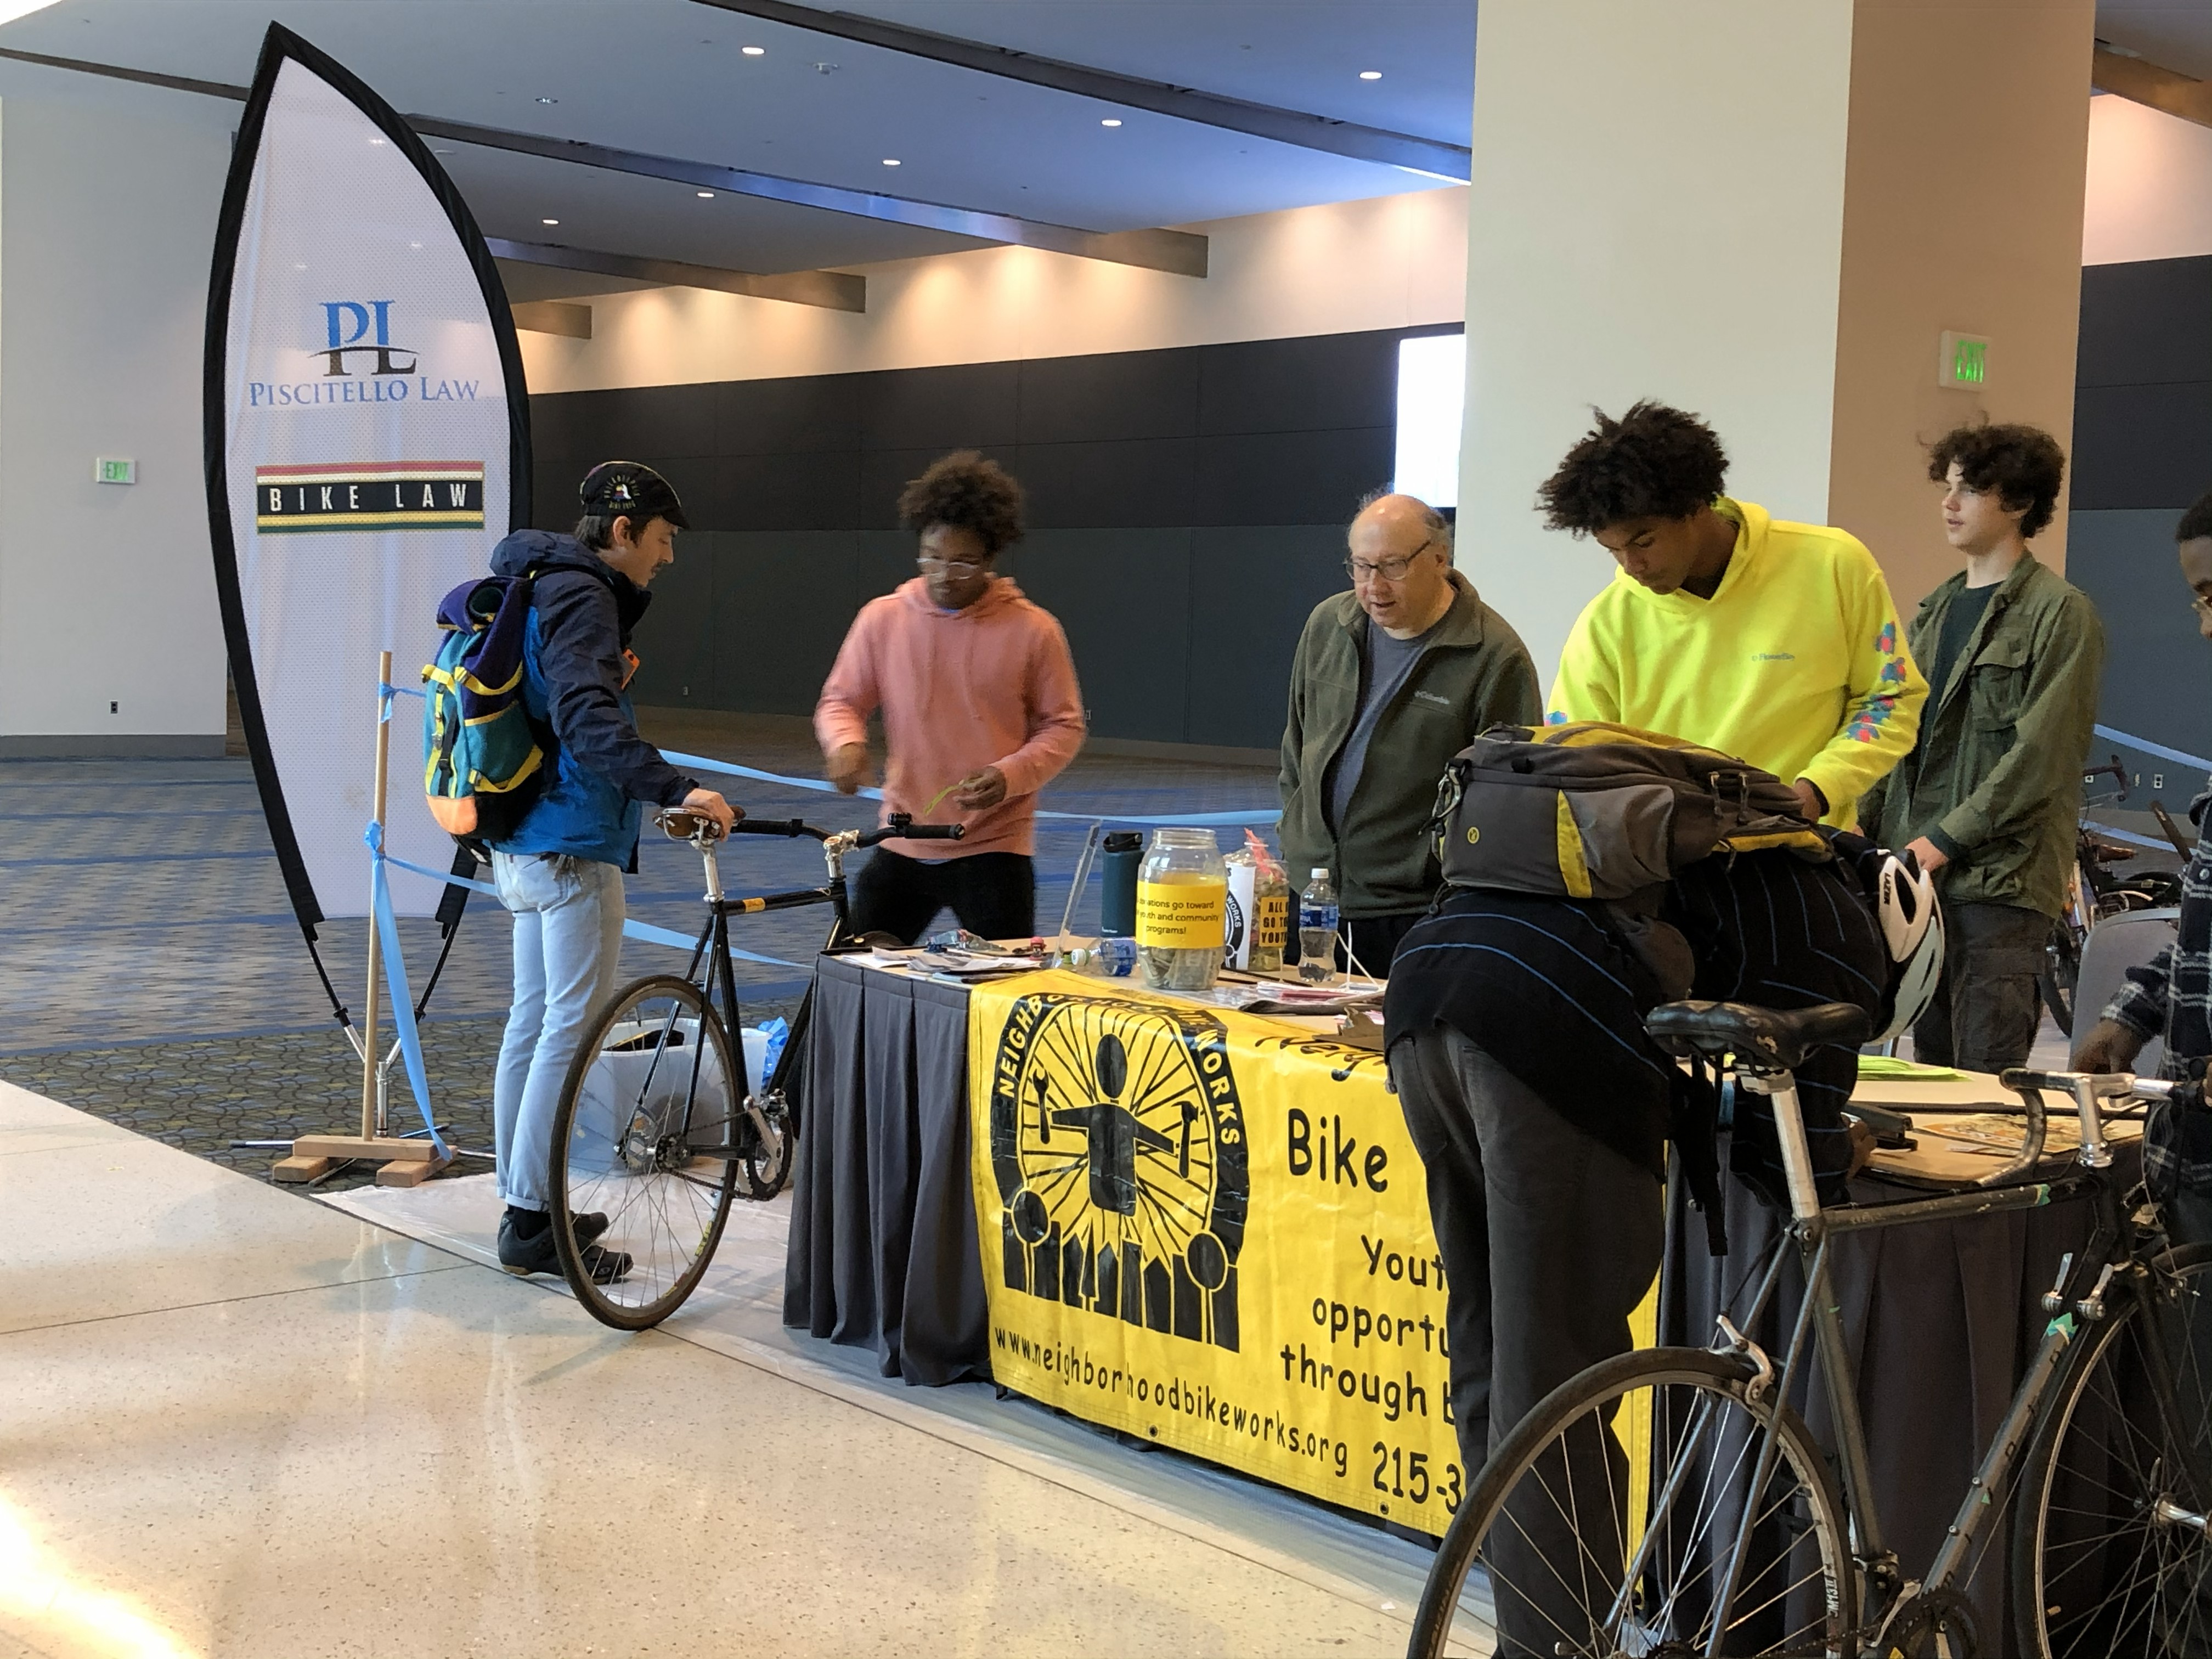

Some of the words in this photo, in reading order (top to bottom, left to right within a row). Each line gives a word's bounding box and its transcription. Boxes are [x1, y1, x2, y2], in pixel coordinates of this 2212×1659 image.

[249, 381, 409, 407] PISCITELLO
[420, 376, 480, 401] LAW
[105, 461, 129, 481] EXIT
[269, 485, 359, 512] BIKE
[395, 483, 467, 508] LAW
[1186, 901, 1214, 909] toward
[1227, 895, 1242, 928] WORKS
[1268, 902, 1283, 913] ALL
[1146, 925, 1187, 935] programs!
[1263, 917, 1276, 928] GO
[998, 994, 1169, 1098] NEIGHBORHOO
[1194, 1029, 1241, 1146] WORKS
[1288, 1108, 1388, 1193] Bike
[1281, 1344, 1427, 1422] through
[995, 1327, 1348, 1478] www.neighborhoodbikeworks.org
